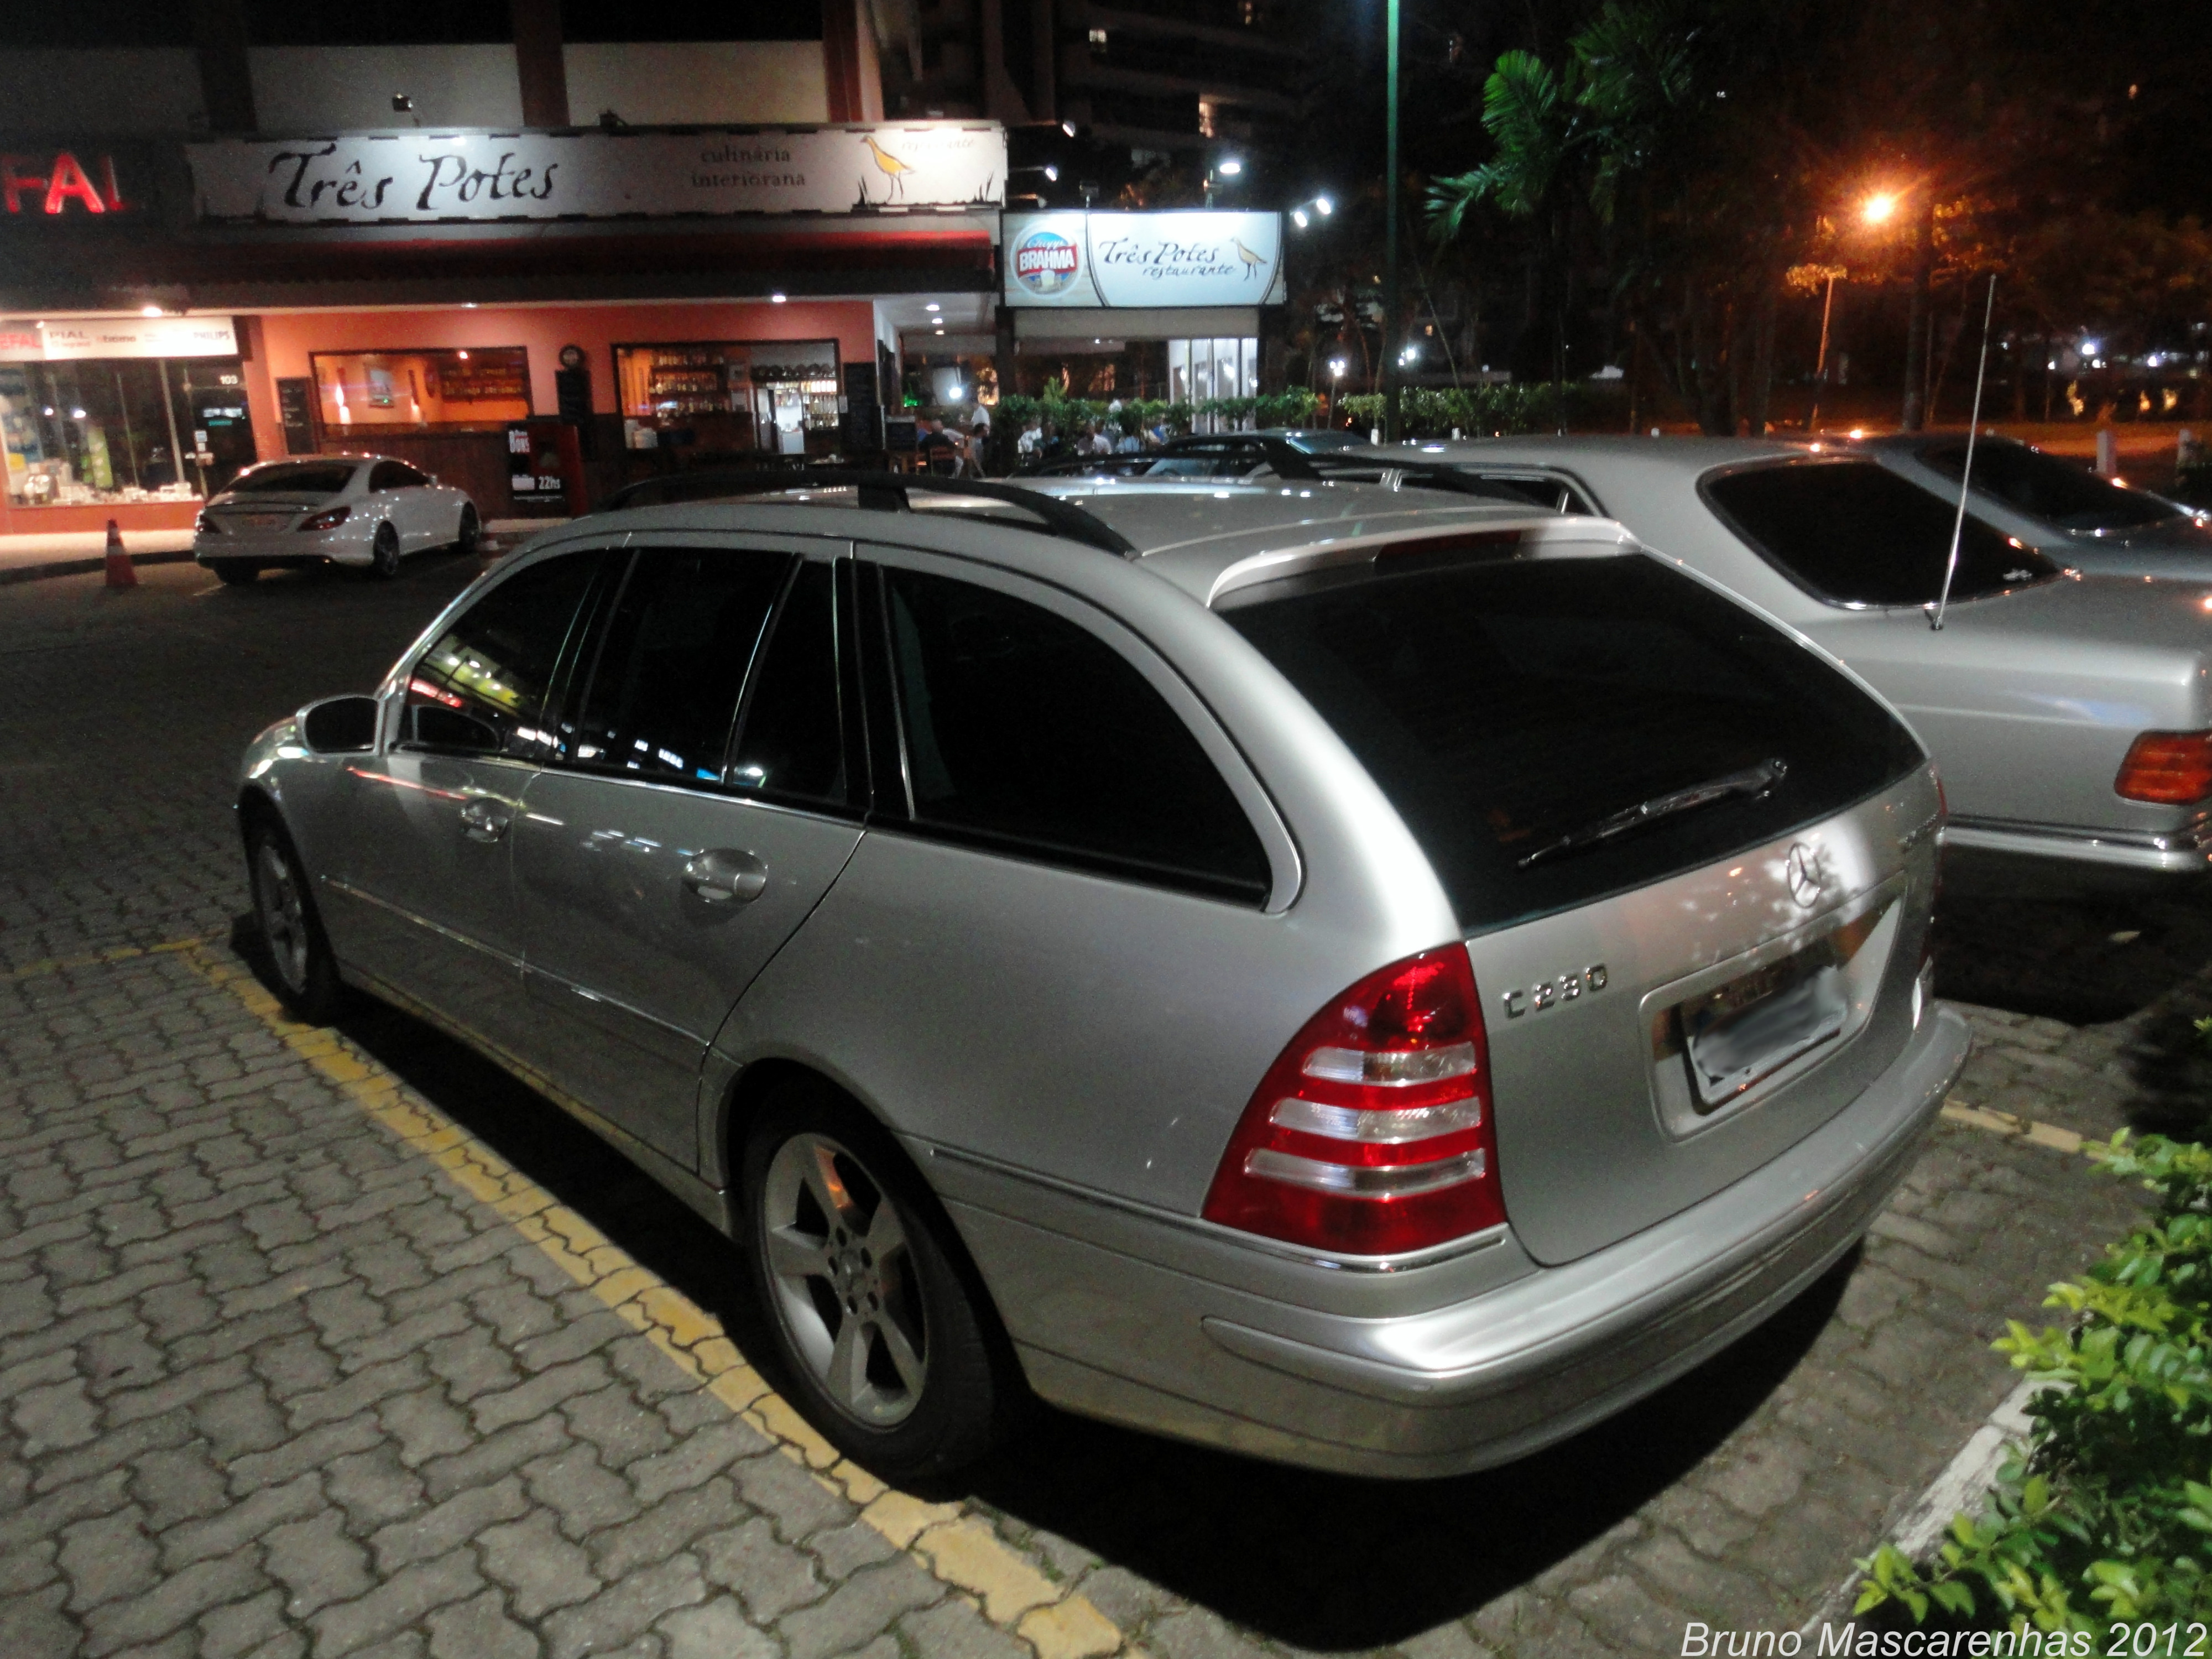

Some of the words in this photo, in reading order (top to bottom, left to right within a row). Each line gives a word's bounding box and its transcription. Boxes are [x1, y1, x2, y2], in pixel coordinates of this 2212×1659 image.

[268, 143, 393, 209] Três
[416, 152, 558, 210] Potes
[1019, 248, 1075, 272] BRAHMA
[1099, 237, 1152, 264] Três
[1153, 241, 1220, 264] Potes
[1142, 262, 1237, 280] restaurante
[220, 374, 238, 385] 103
